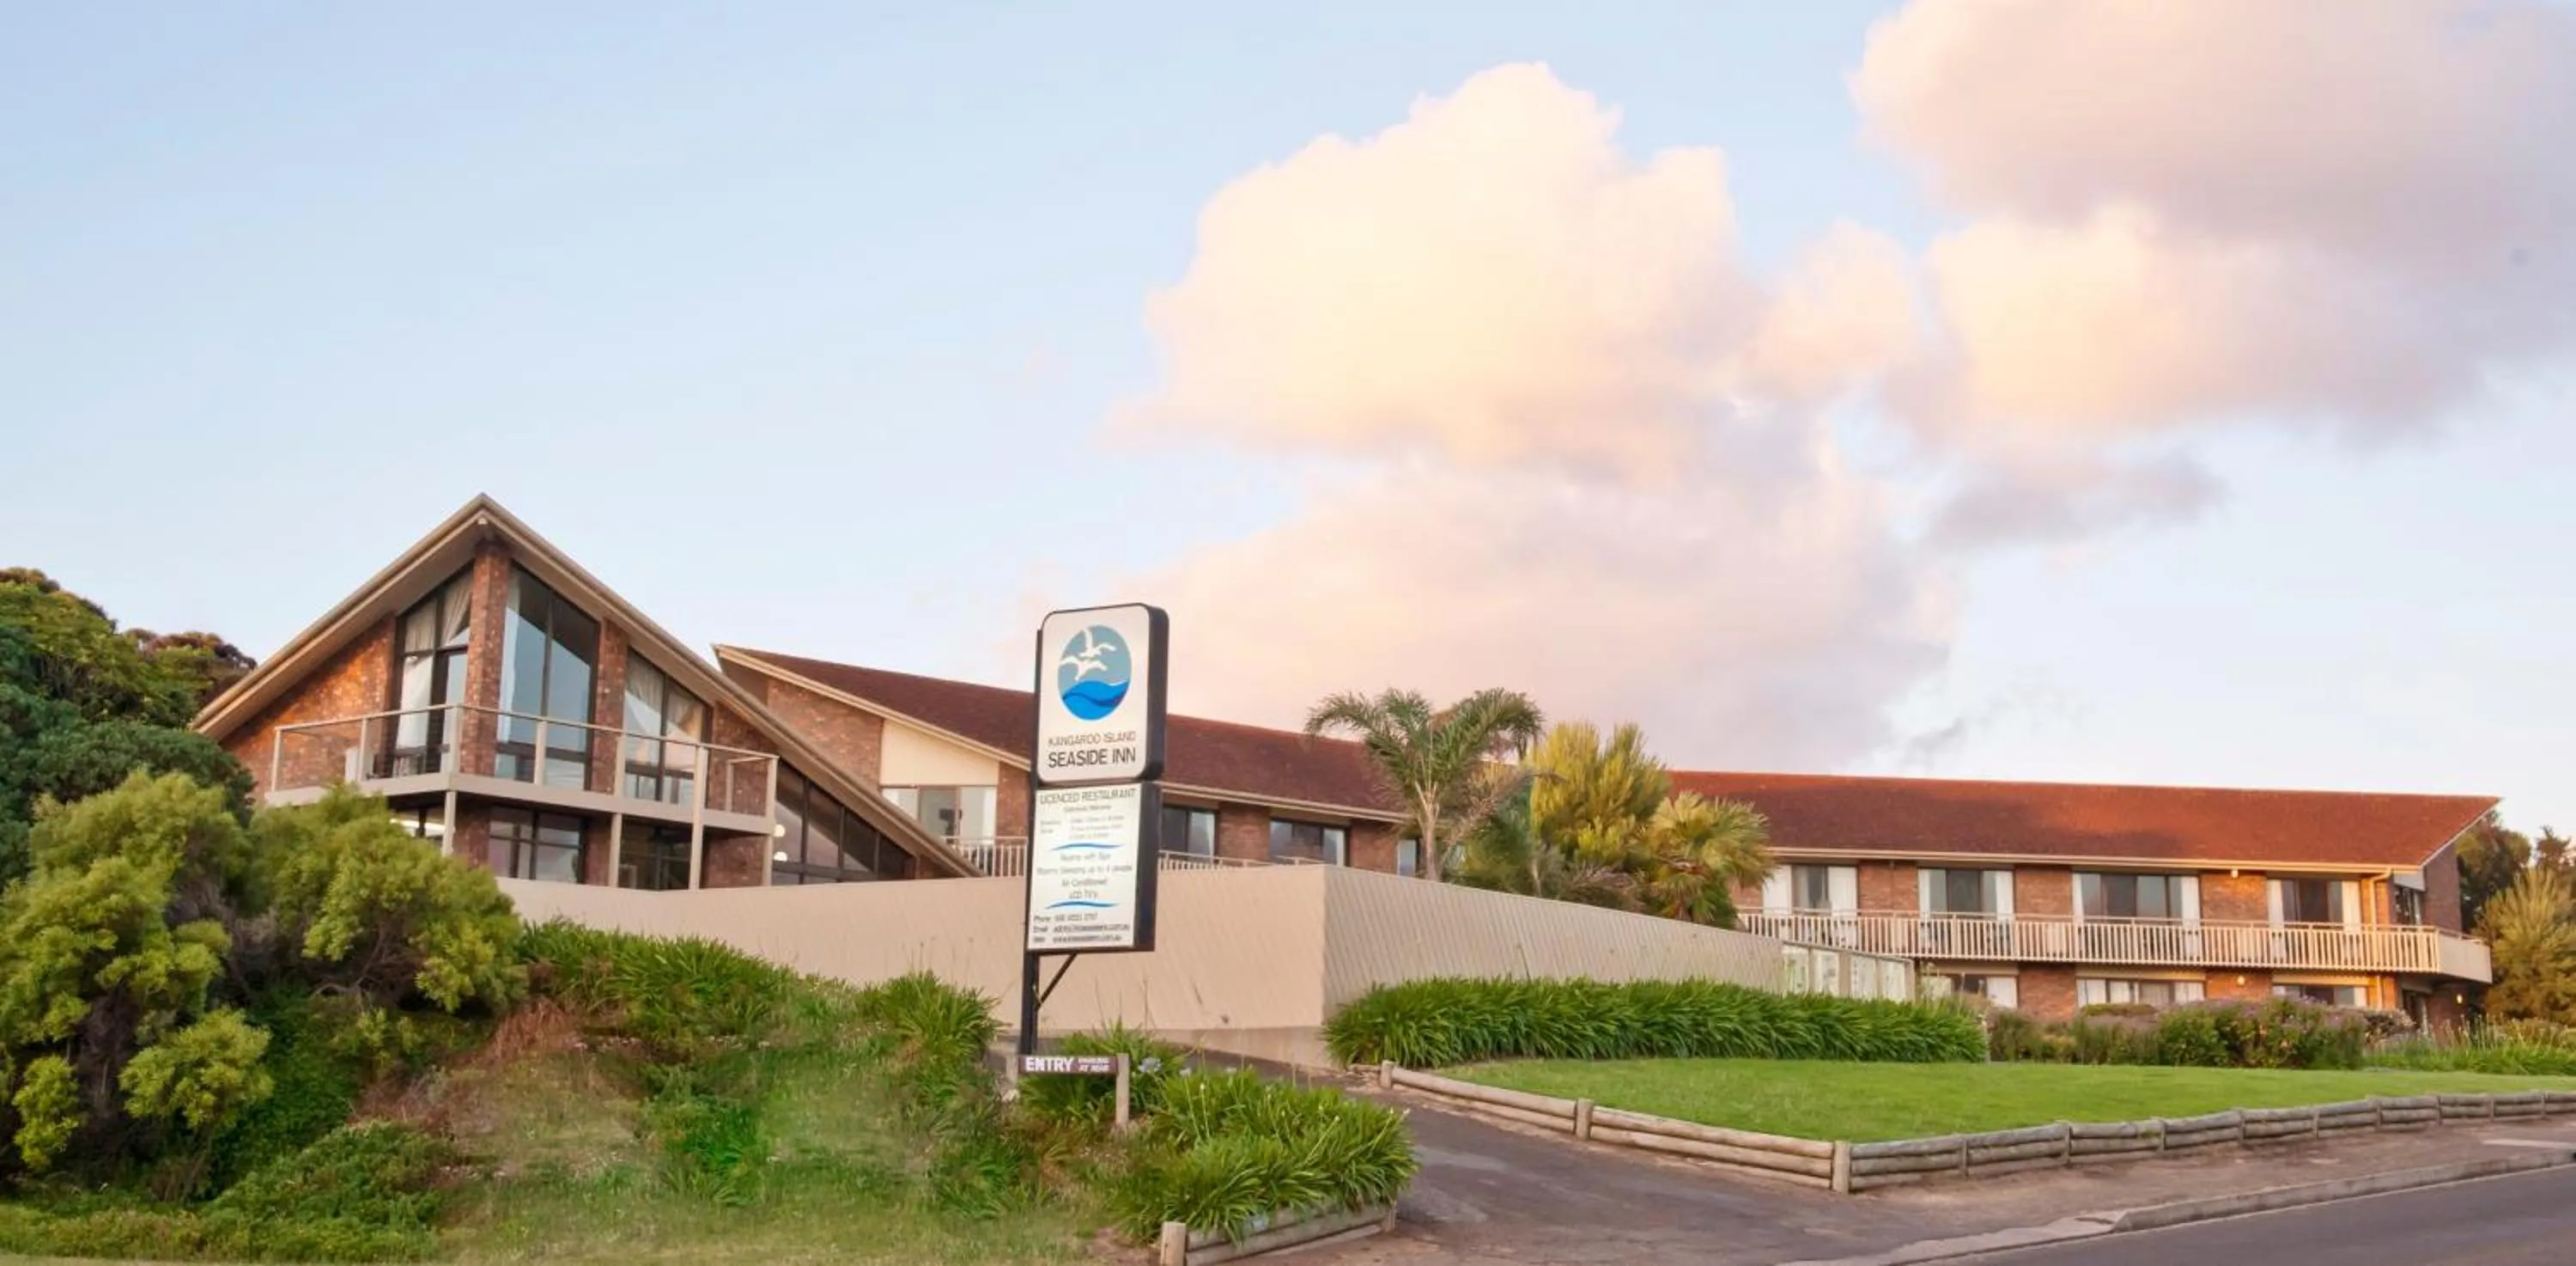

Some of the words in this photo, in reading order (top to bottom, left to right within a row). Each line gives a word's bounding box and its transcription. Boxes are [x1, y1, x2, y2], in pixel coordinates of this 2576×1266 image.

[1048, 733, 1100, 746] KANGAROO
[1103, 731, 1136, 743] ISLAND
[1048, 748, 1108, 769] SEASIDE
[1112, 747, 1136, 763] INN
[1025, 1056, 1074, 1072] ENTRY
